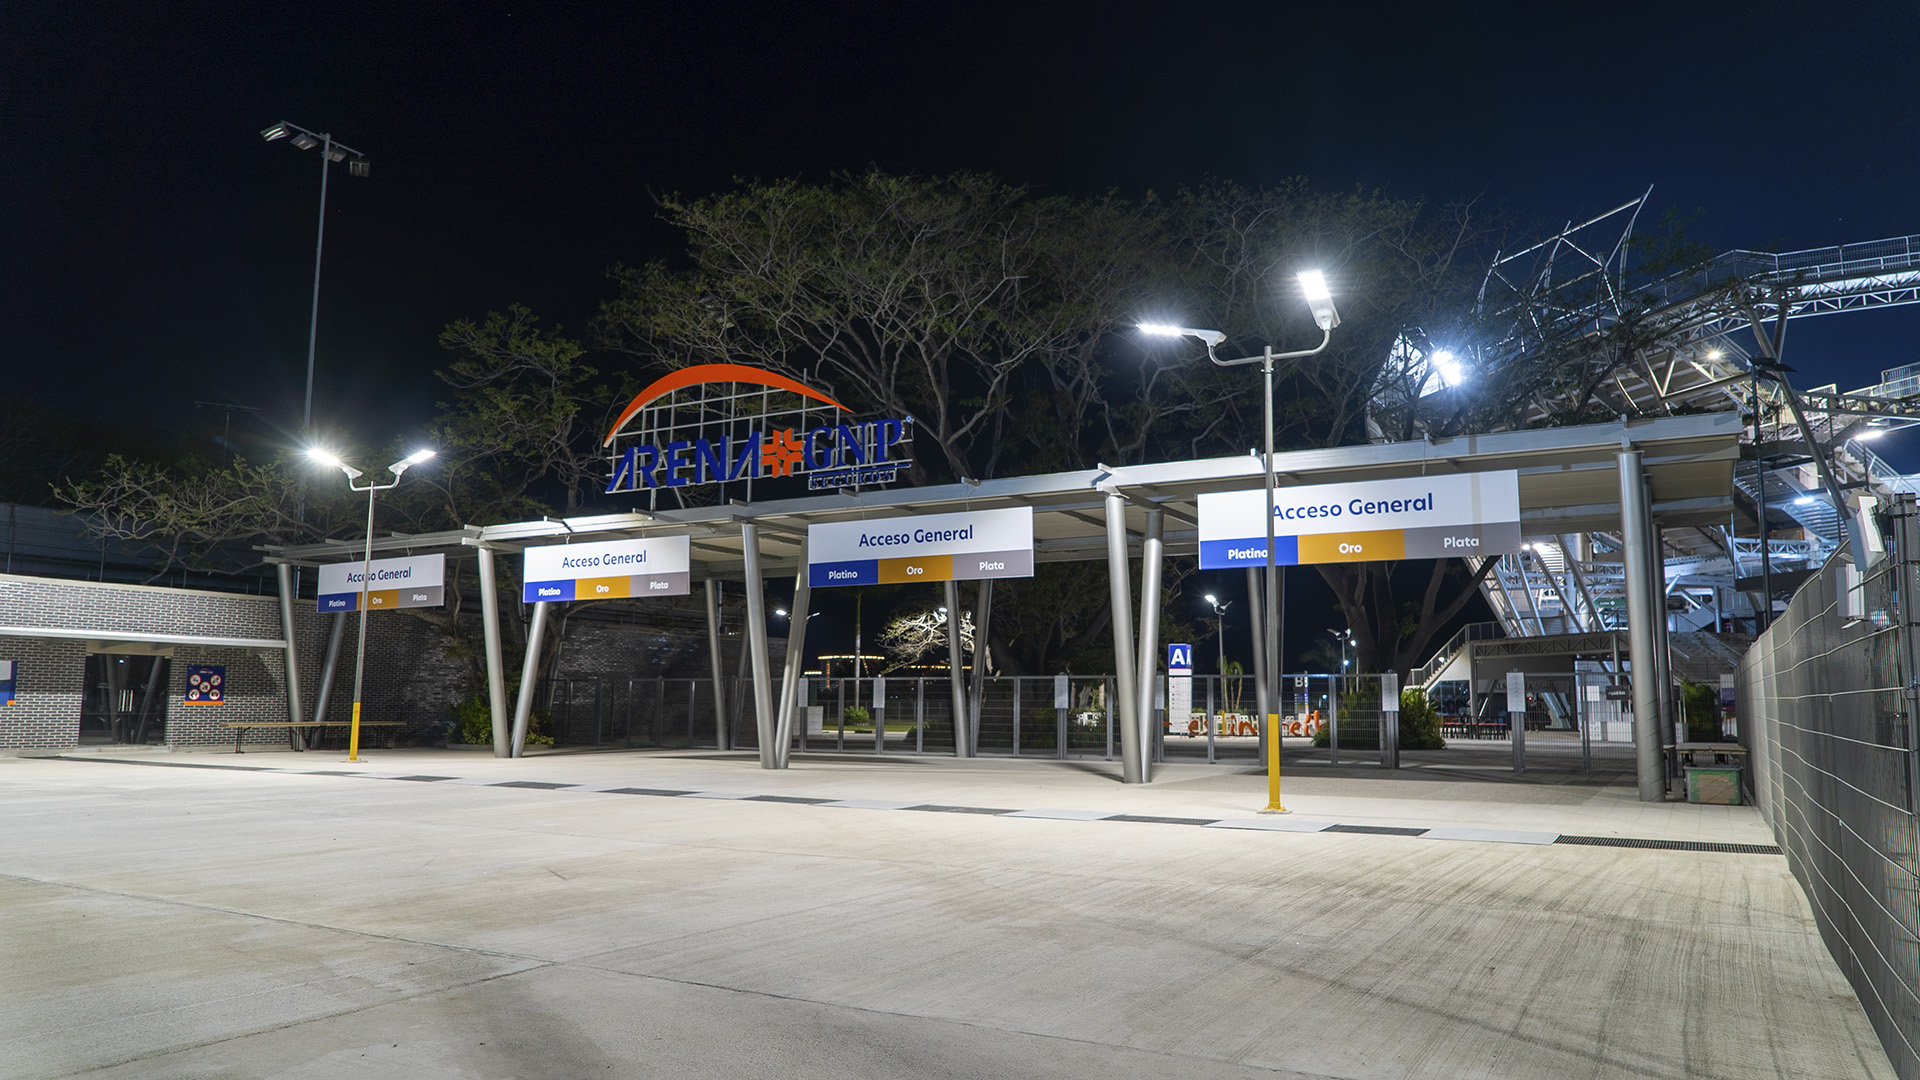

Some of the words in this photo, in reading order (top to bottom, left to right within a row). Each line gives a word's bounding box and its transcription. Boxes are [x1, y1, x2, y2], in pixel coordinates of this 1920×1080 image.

[605, 431, 761, 494] ARENA
[804, 418, 904, 471] GNP
[810, 470, 893, 489] SEGUROS
[1273, 504, 1342, 521] Acceso
[1348, 492, 1434, 517] General
[859, 533, 910, 547] Acceso
[913, 524, 973, 544] General
[1443, 536, 1480, 549] Plata
[1227, 547, 1268, 560] Platino
[1338, 543, 1363, 554] Oro
[562, 557, 600, 569] Acceso
[602, 550, 647, 566] General
[906, 566, 924, 576] Oro
[979, 561, 1005, 571] Plata
[377, 566, 412, 581] General
[828, 569, 858, 580] Platino
[596, 585, 610, 594] Oro
[650, 581, 669, 590] Plata
[412, 593, 428, 602] Plata
[538, 587, 561, 597] Platino
[328, 599, 346, 608] Platino
[372, 597, 383, 605] Oro
[1170, 648, 1186, 666] A
[1294, 676, 1304, 688] B
